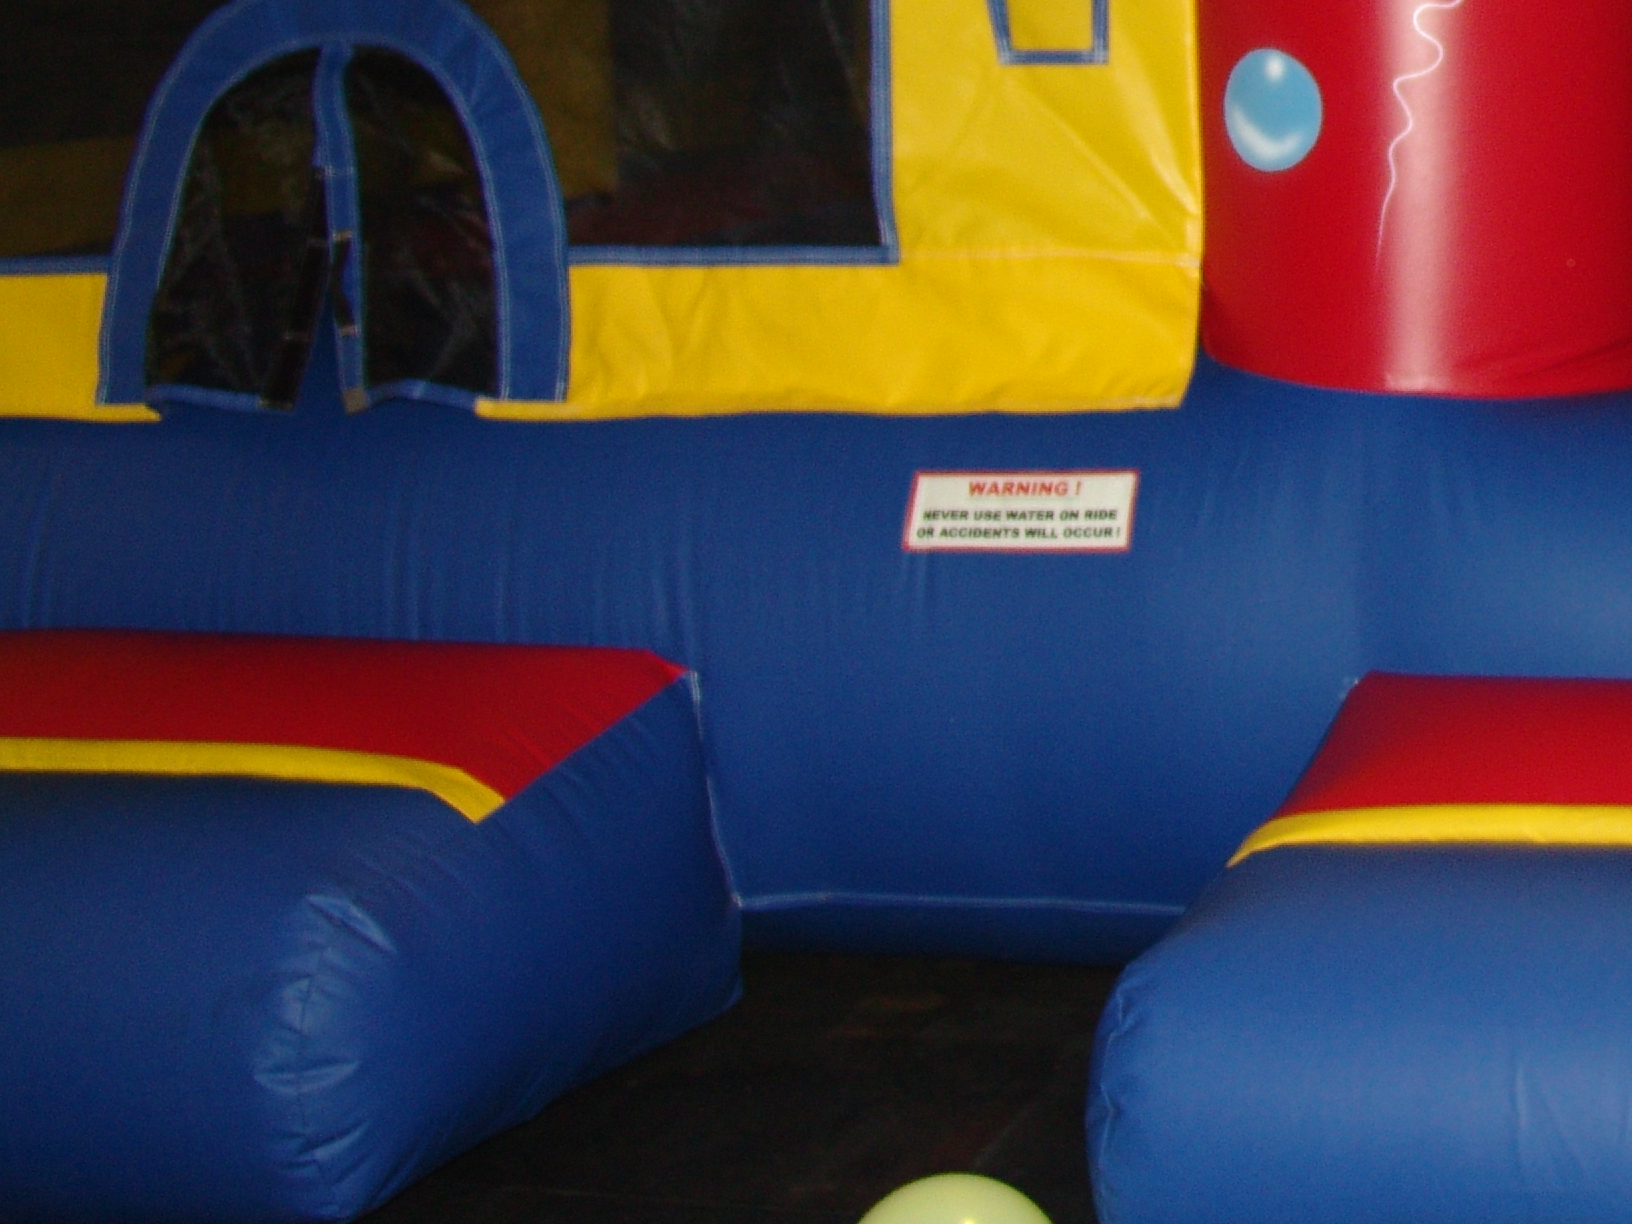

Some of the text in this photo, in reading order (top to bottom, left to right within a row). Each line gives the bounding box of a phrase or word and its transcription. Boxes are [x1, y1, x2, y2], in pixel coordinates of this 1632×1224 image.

[968, 481, 1069, 497] WARNING
[923, 509, 1118, 521] NEVER USE WATER ON RIDE
[916, 527, 934, 539] OR
[939, 527, 1020, 539] ACCIDENTS
[1025, 527, 1058, 539] WILL
